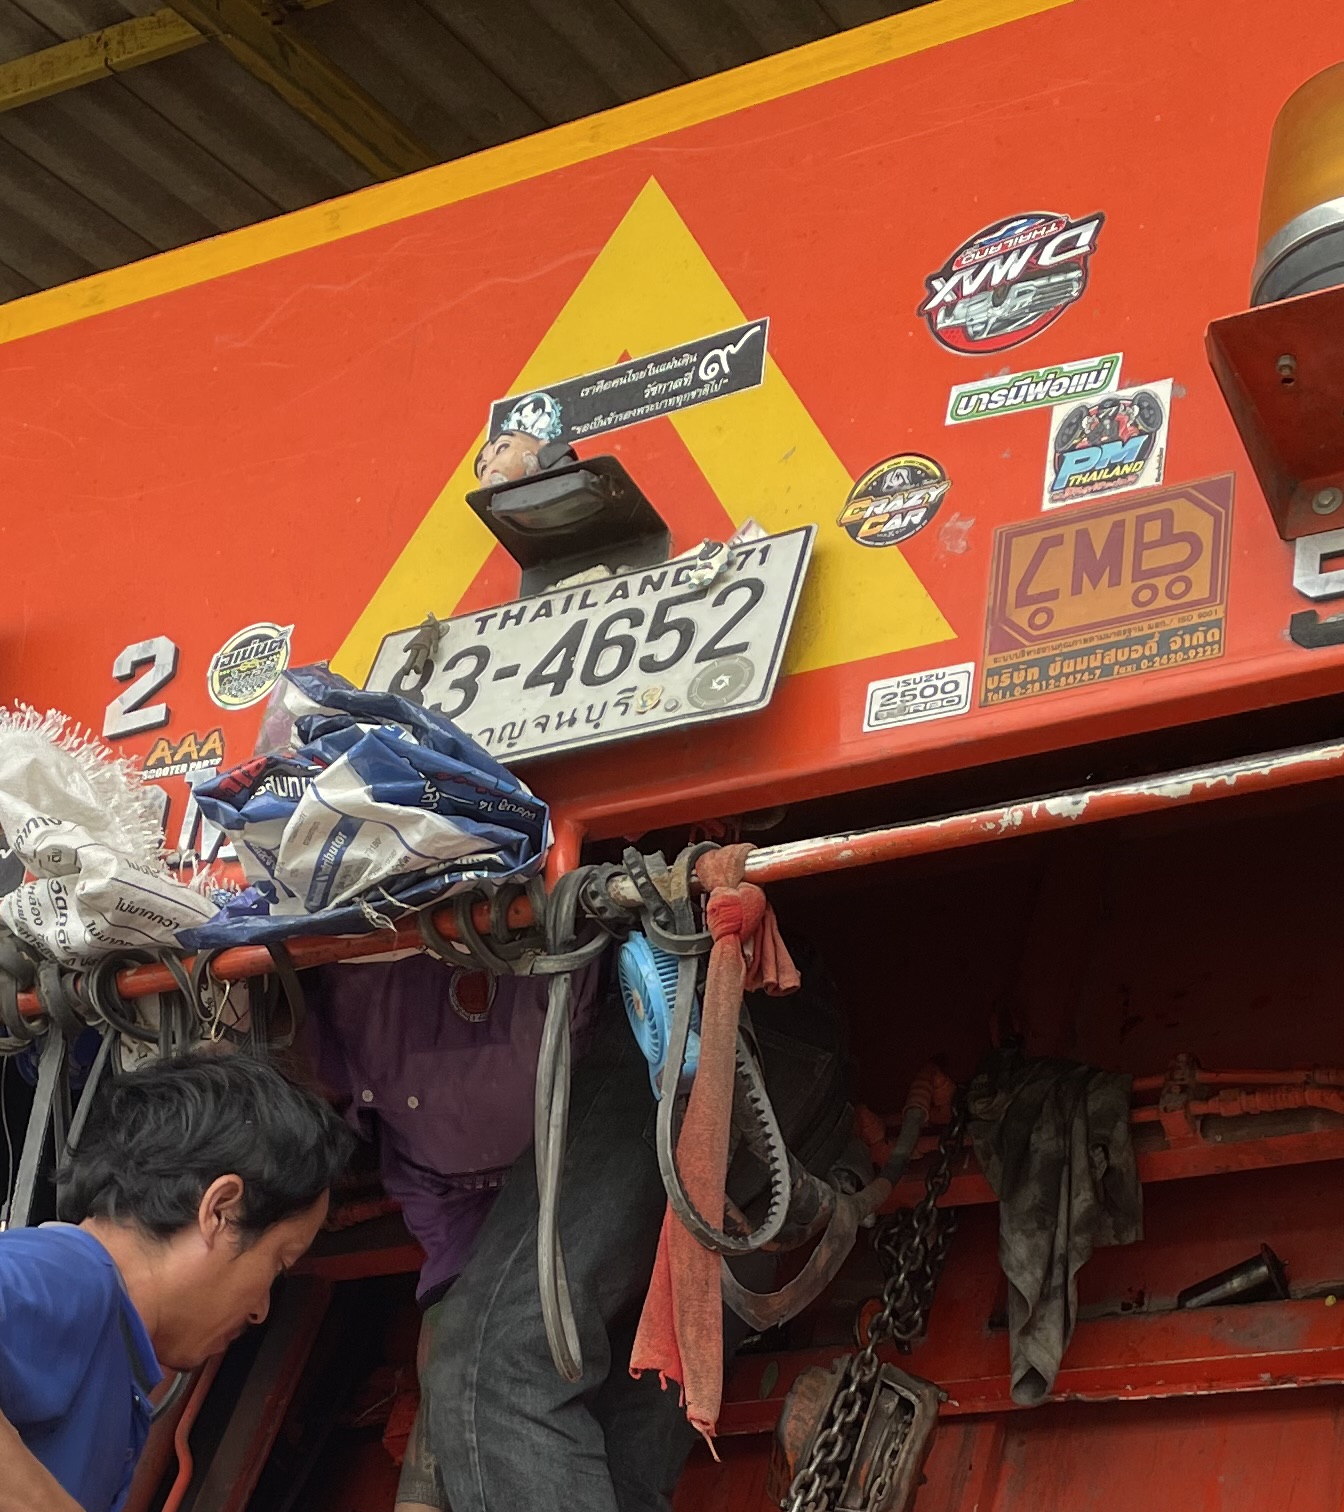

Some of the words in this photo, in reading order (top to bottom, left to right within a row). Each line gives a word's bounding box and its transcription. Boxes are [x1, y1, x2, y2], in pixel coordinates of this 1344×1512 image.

[955, 360, 1112, 416] บารมีพ่อแม่
[1052, 435, 1148, 491] PM
[1069, 461, 1144, 487] THAILAND
[837, 480, 953, 527] CRAZY
[858, 507, 929, 538] CAR
[1014, 507, 1204, 609] CMB
[475, 565, 697, 635] THAILAND
[735, 544, 771, 572] 71
[896, 671, 946, 689] ISUZU
[987, 663, 1040, 690] บริษัท
[1169, 625, 1221, 651] จำกัด
[102, 635, 180, 740] 2
[880, 679, 960, 708] 2500
[467, 687, 637, 748] าญจนบุรี
[142, 763, 188, 782] SCOOTER
[145, 728, 224, 767] AAA
